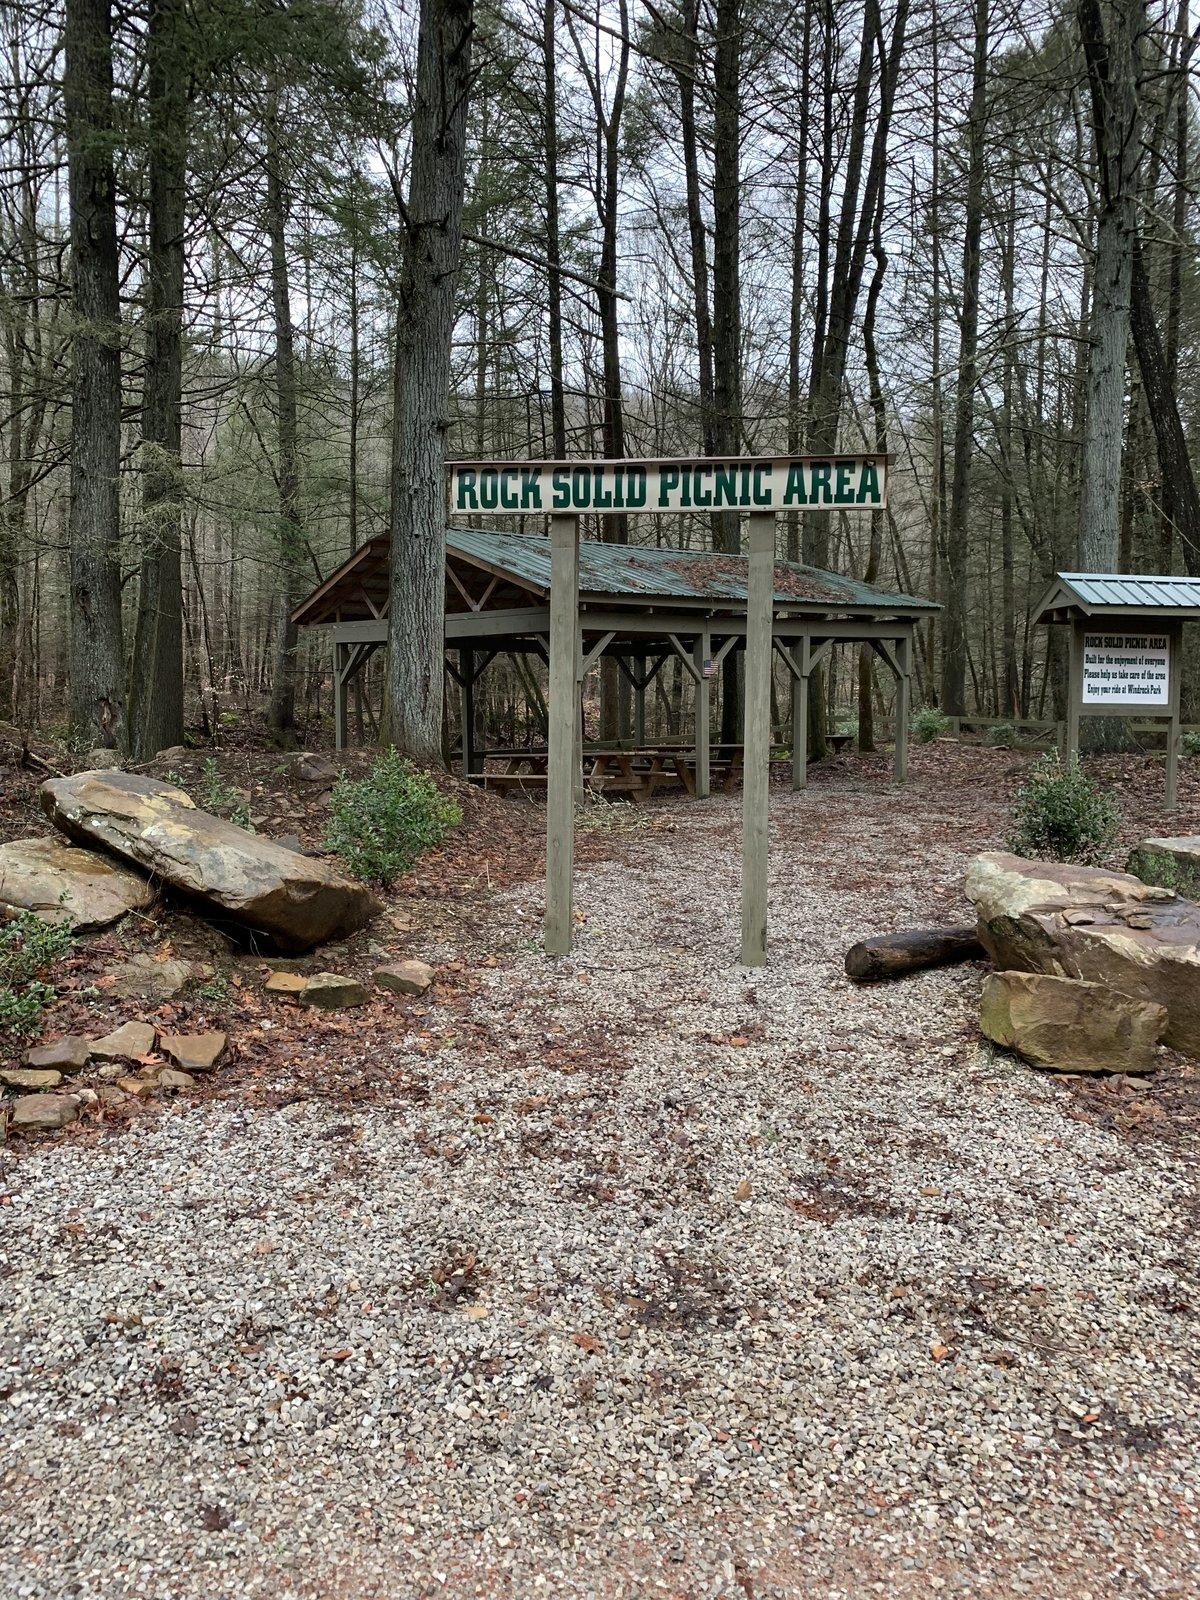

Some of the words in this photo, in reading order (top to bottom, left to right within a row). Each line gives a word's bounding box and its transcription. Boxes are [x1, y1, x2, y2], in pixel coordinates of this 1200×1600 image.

[456, 467, 543, 509] ROCK
[552, 465, 646, 508] SOLID
[658, 463, 772, 507] PICNIC
[783, 460, 881, 505] AREA
[1085, 636, 1103, 648] ROCK
[1104, 636, 1123, 649] SOLID
[1125, 637, 1147, 649] PICNIC
[1149, 638, 1167, 650] AREA
[1085, 654, 1096, 664] Built
[1114, 655, 1137, 667] enjoyment
[1139, 655, 1144, 665] of
[1145, 658, 1165, 667] everyone
[1084, 668, 1100, 678] Please
[1101, 669, 1110, 681] help
[1118, 669, 1128, 679] take
[1141, 670, 1146, 679] of
[1087, 683, 1100, 695] Enjoy
[1101, 686, 1111, 696] your
[1112, 684, 1121, 693] ride
[1122, 685, 1127, 693] at
[1127, 684, 1149, 694] Windrock
[1150, 684, 1161, 694] Park
